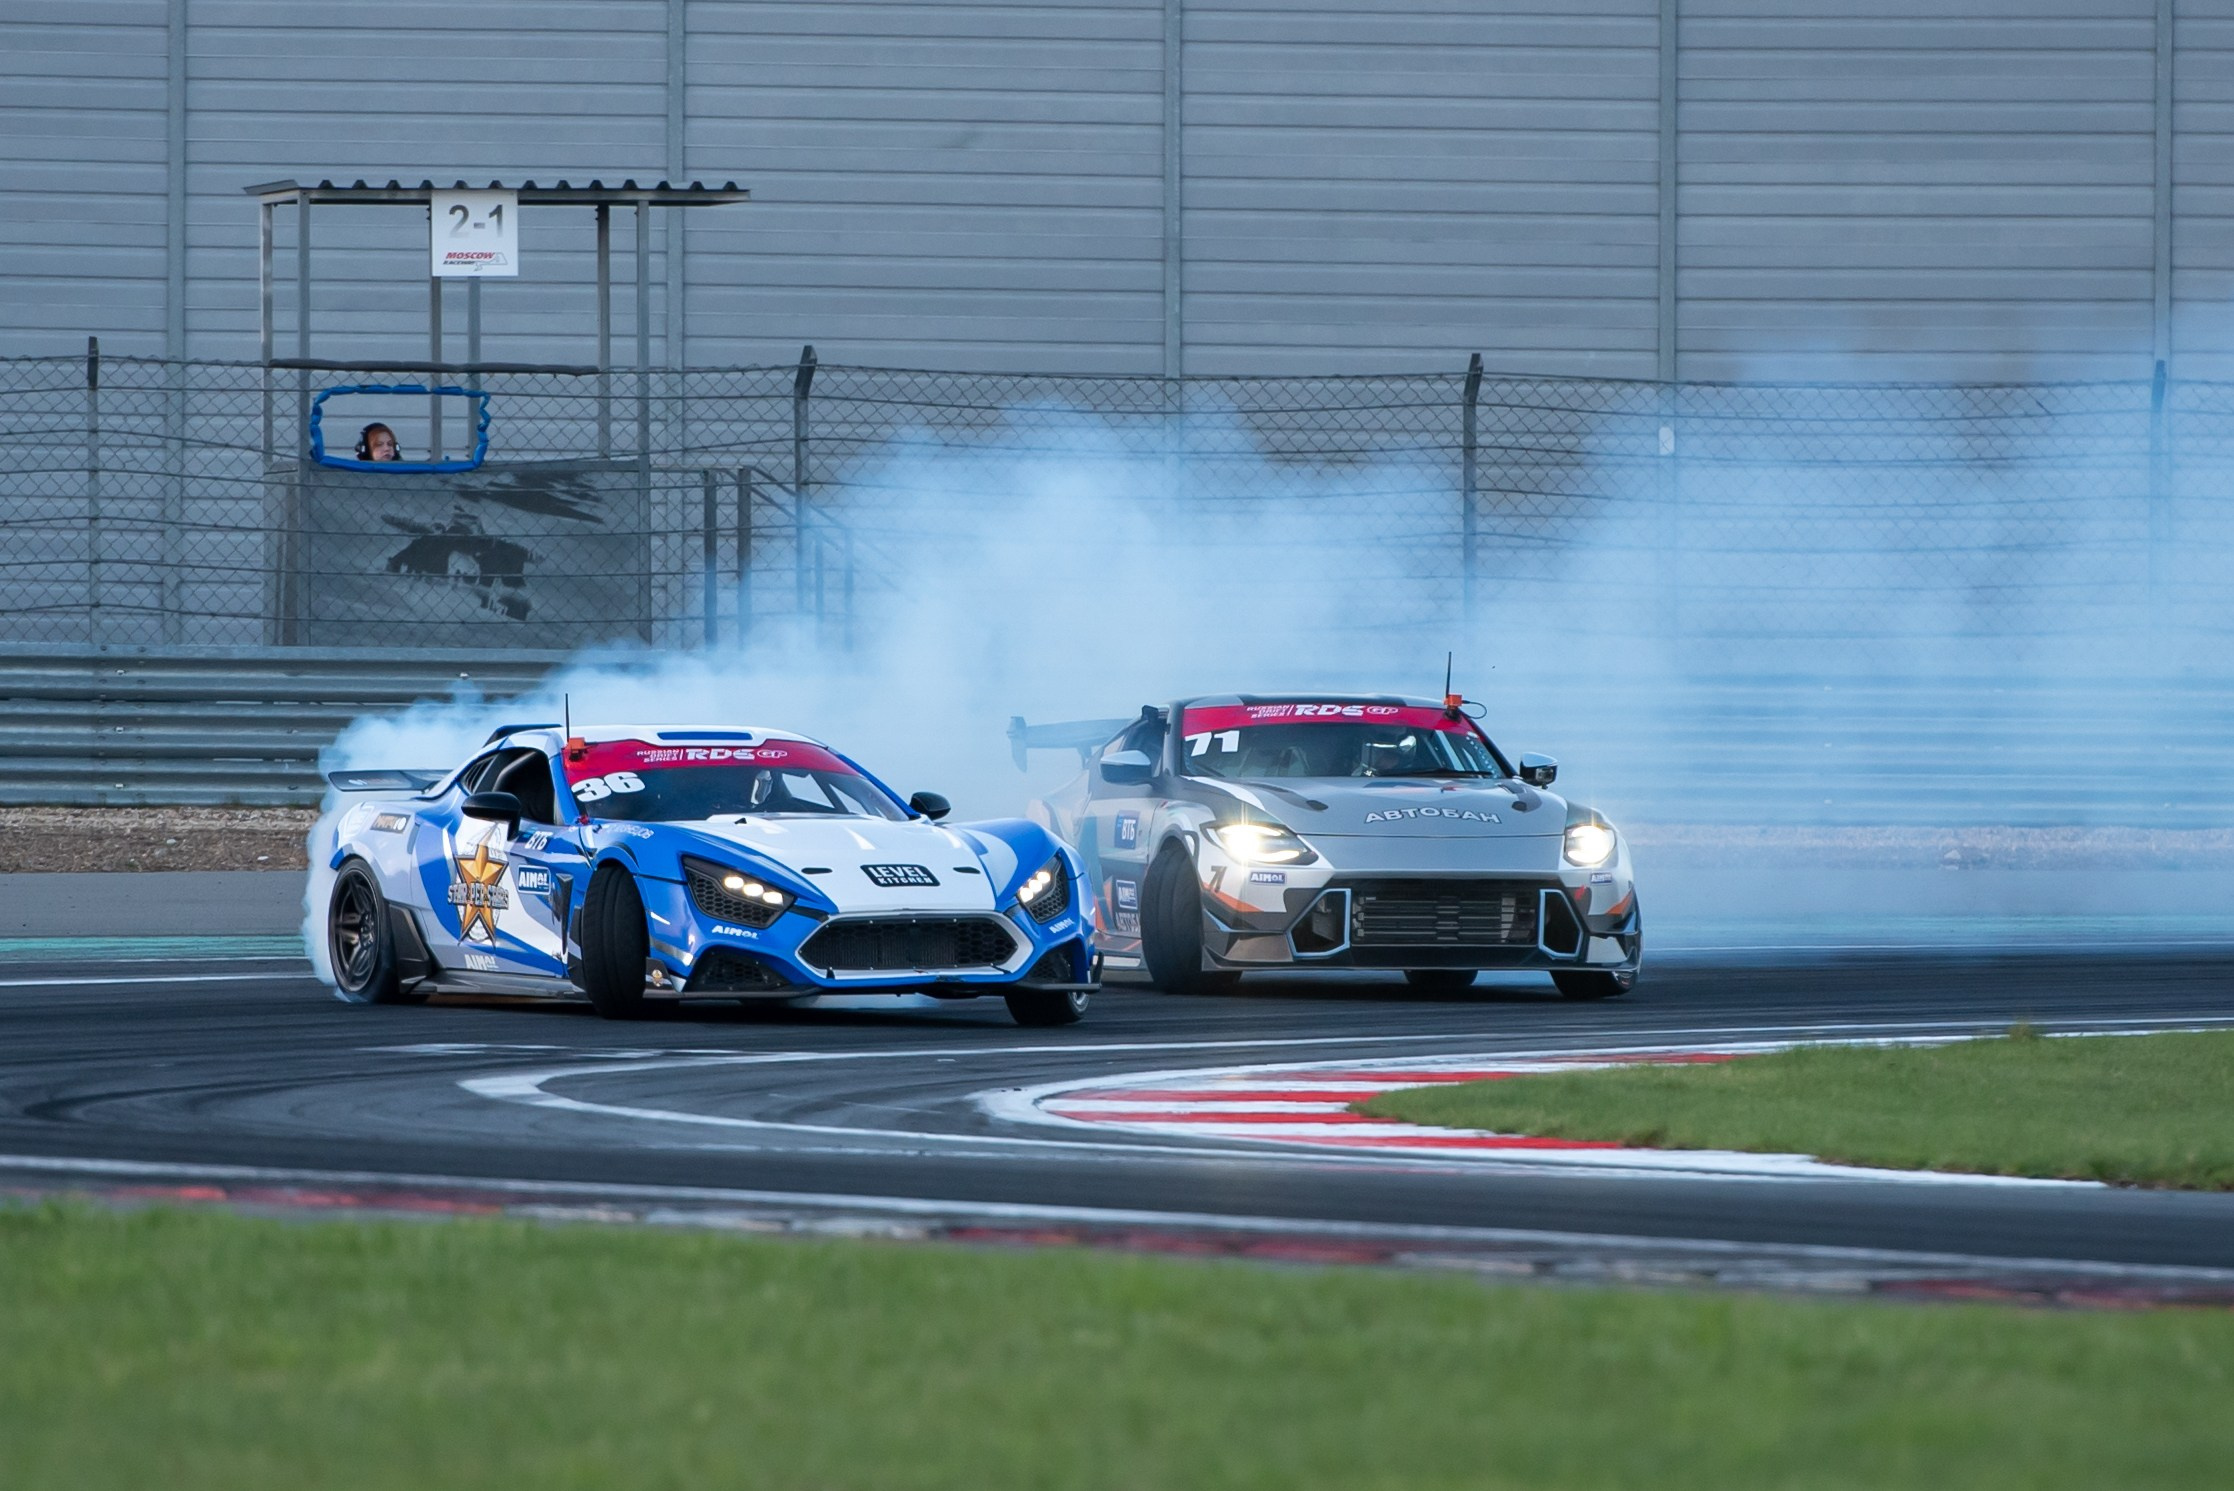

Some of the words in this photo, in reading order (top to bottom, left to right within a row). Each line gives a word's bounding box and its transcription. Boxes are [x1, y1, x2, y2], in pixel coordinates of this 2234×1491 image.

[448, 204, 504, 238] 2-1
[446, 251, 495, 259] MOSCOW
[1184, 730, 1240, 757] 71
[571, 772, 646, 802] 36
[1365, 807, 1502, 823] АВТОБАН
[1121, 819, 1136, 840] ВТБ
[868, 866, 928, 878] LEVEL
[1250, 873, 1284, 882] AIMOL
[711, 925, 759, 939] AIMOL
